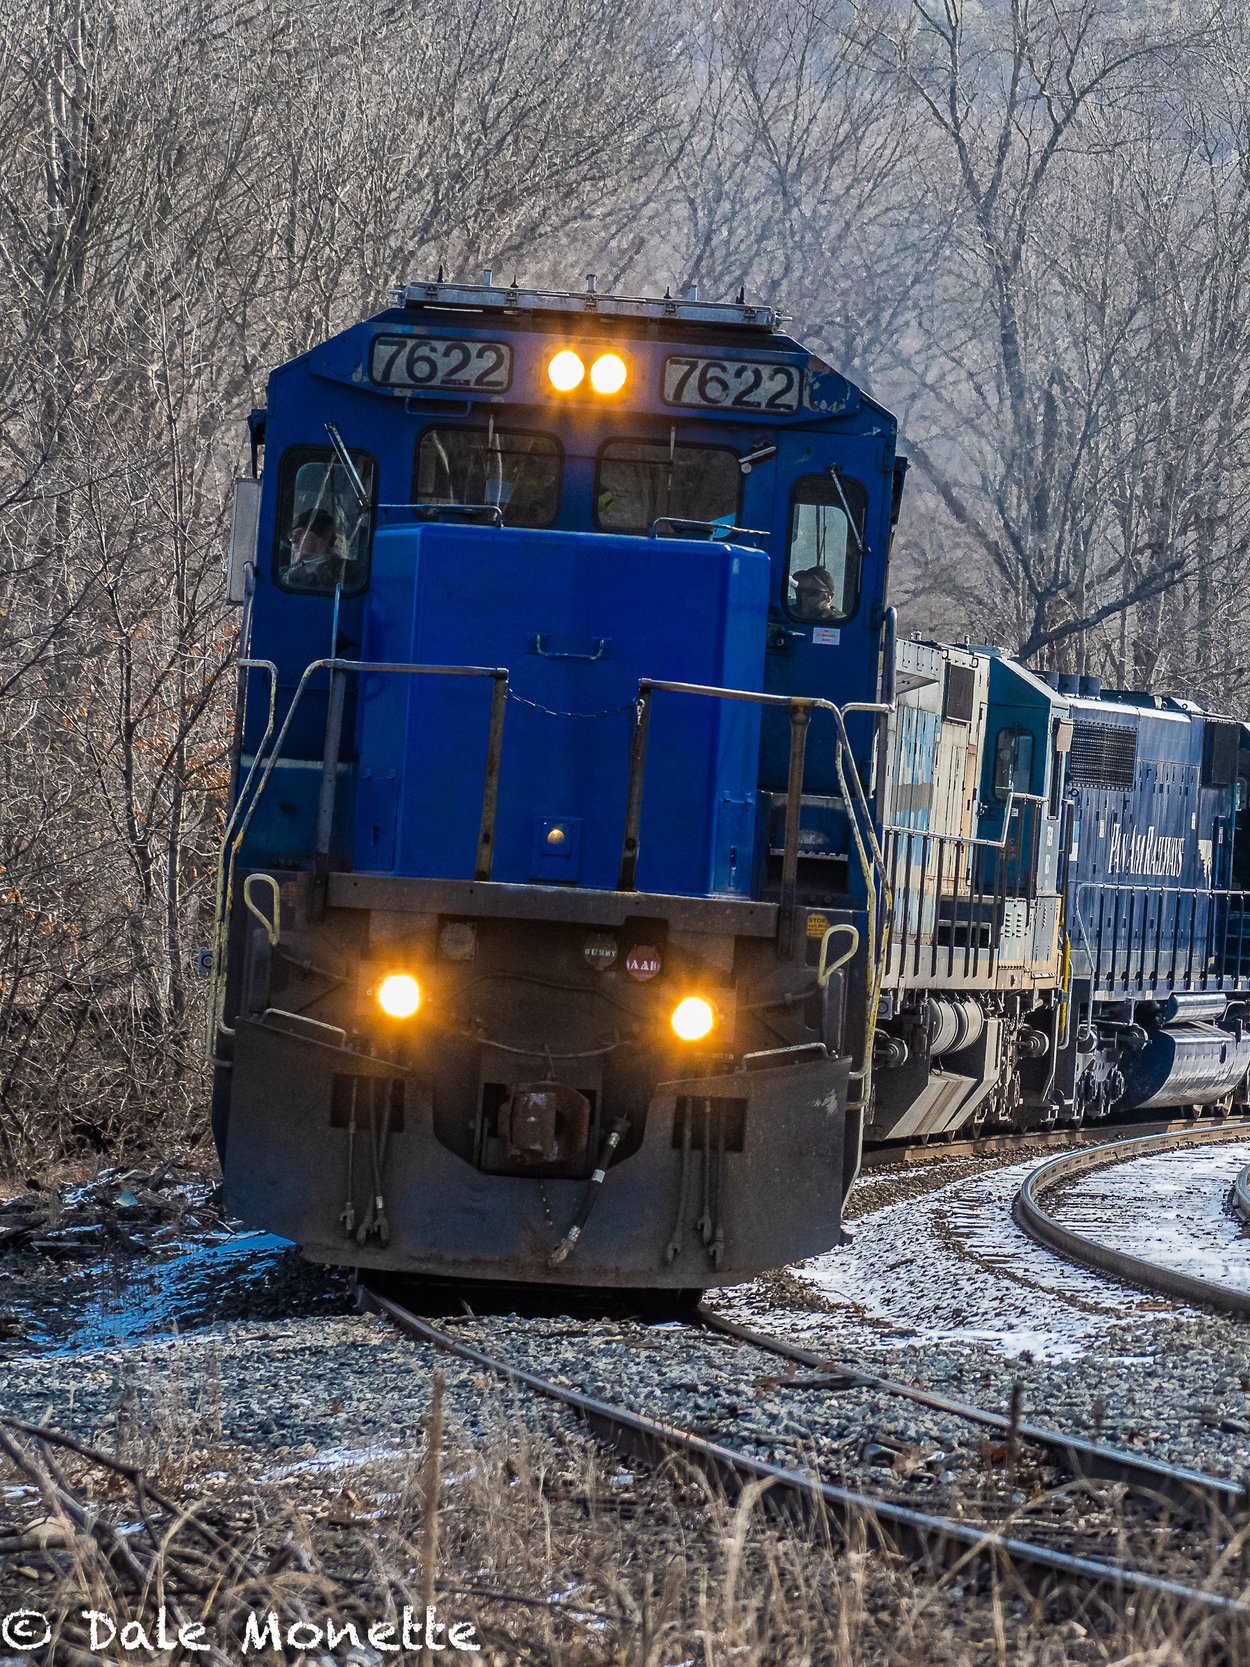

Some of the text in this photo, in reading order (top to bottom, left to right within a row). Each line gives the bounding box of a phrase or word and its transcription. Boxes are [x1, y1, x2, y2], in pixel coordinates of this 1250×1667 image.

[377, 339, 505, 387] 7622
[668, 357, 795, 411] 7622
[1108, 823, 1129, 874] PAN
[1130, 824, 1147, 875] AM
